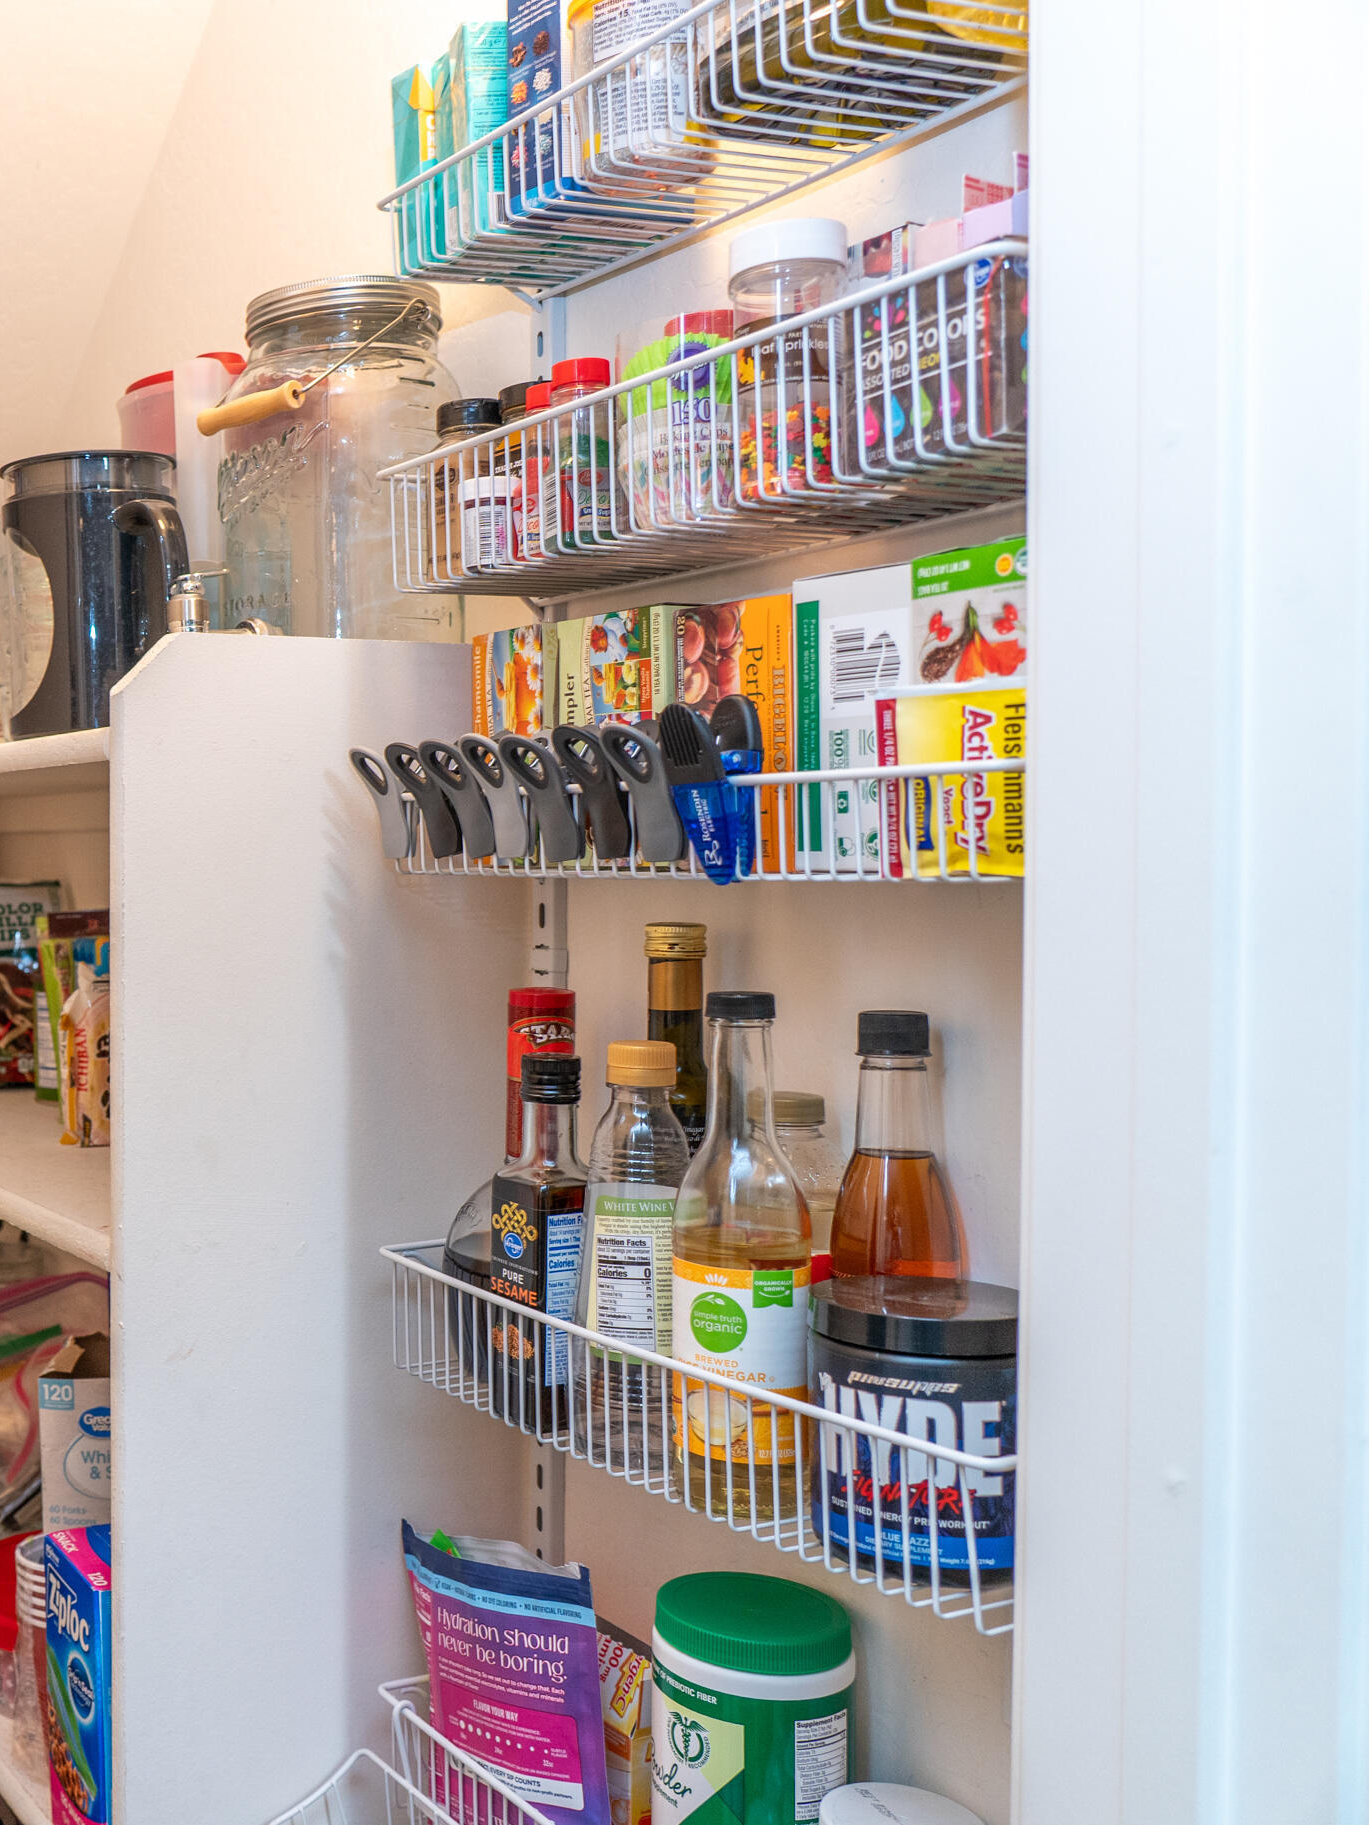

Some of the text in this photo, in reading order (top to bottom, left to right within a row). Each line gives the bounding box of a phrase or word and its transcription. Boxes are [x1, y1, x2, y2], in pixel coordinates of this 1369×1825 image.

[619, 9, 629, 18] 15
[701, 427, 728, 439] Cps
[677, 616, 685, 635] 20
[654, 643, 661, 652] WT
[745, 645, 765, 706] Perf
[582, 677, 591, 699] TEA
[564, 673, 578, 724] mpler
[772, 665, 786, 772] BIGELO
[1003, 703, 1026, 855] Fleishmann's
[691, 789, 712, 842] ROSENDIN
[914, 778, 927, 846] ORIGINAL
[76, 1028, 88, 1092] ICHIBAN
[604, 1201, 668, 1212] WHITE WINE
[549, 1216, 576, 1228] Nutrition
[598, 1237, 647, 1247] Nutrition Facts
[549, 1259, 575, 1270] Calories
[598, 1267, 651, 1278] Calories 0
[502, 1268, 525, 1285] PURE
[753, 1279, 793, 1287] ORGANICALLY
[490, 1276, 538, 1308] SESAME
[763, 1285, 786, 1293] GROWN
[694, 1310, 742, 1325] simple truth
[693, 1318, 743, 1336] organic
[694, 1353, 739, 1369] BREWED
[703, 1366, 767, 1384] VINEGAR
[42, 1383, 73, 1402] 120
[822, 1383, 1004, 1497] HYDE
[80, 1449, 111, 1465] Whi
[89, 1466, 101, 1480] &
[831, 1495, 873, 1517] SUSTNED
[52, 1531, 80, 1554] SNACK
[87, 1572, 108, 1587] 120
[48, 1571, 91, 1653] Ziploc
[524, 1603, 531, 1611] NO
[532, 1604, 557, 1616] ARTIFICIAL
[557, 1608, 583, 1619] FLAVORING
[437, 1606, 500, 1643] Hydration
[503, 1629, 569, 1655] should
[438, 1632, 473, 1657] never
[476, 1643, 496, 1665] be
[500, 1650, 568, 1684] boring.
[517, 1682, 537, 1691] change
[551, 1687, 566, 1695] Each
[529, 1690, 540, 1699] and
[540, 1693, 565, 1704] minerals
[666, 1674, 696, 1698] PREBIOTIC
[696, 1690, 718, 1705] FIBER
[473, 1699, 519, 1722] FLAVOR YOUR WAY
[796, 1716, 833, 1729] Supplement
[515, 1775, 542, 1787] COUNTS
